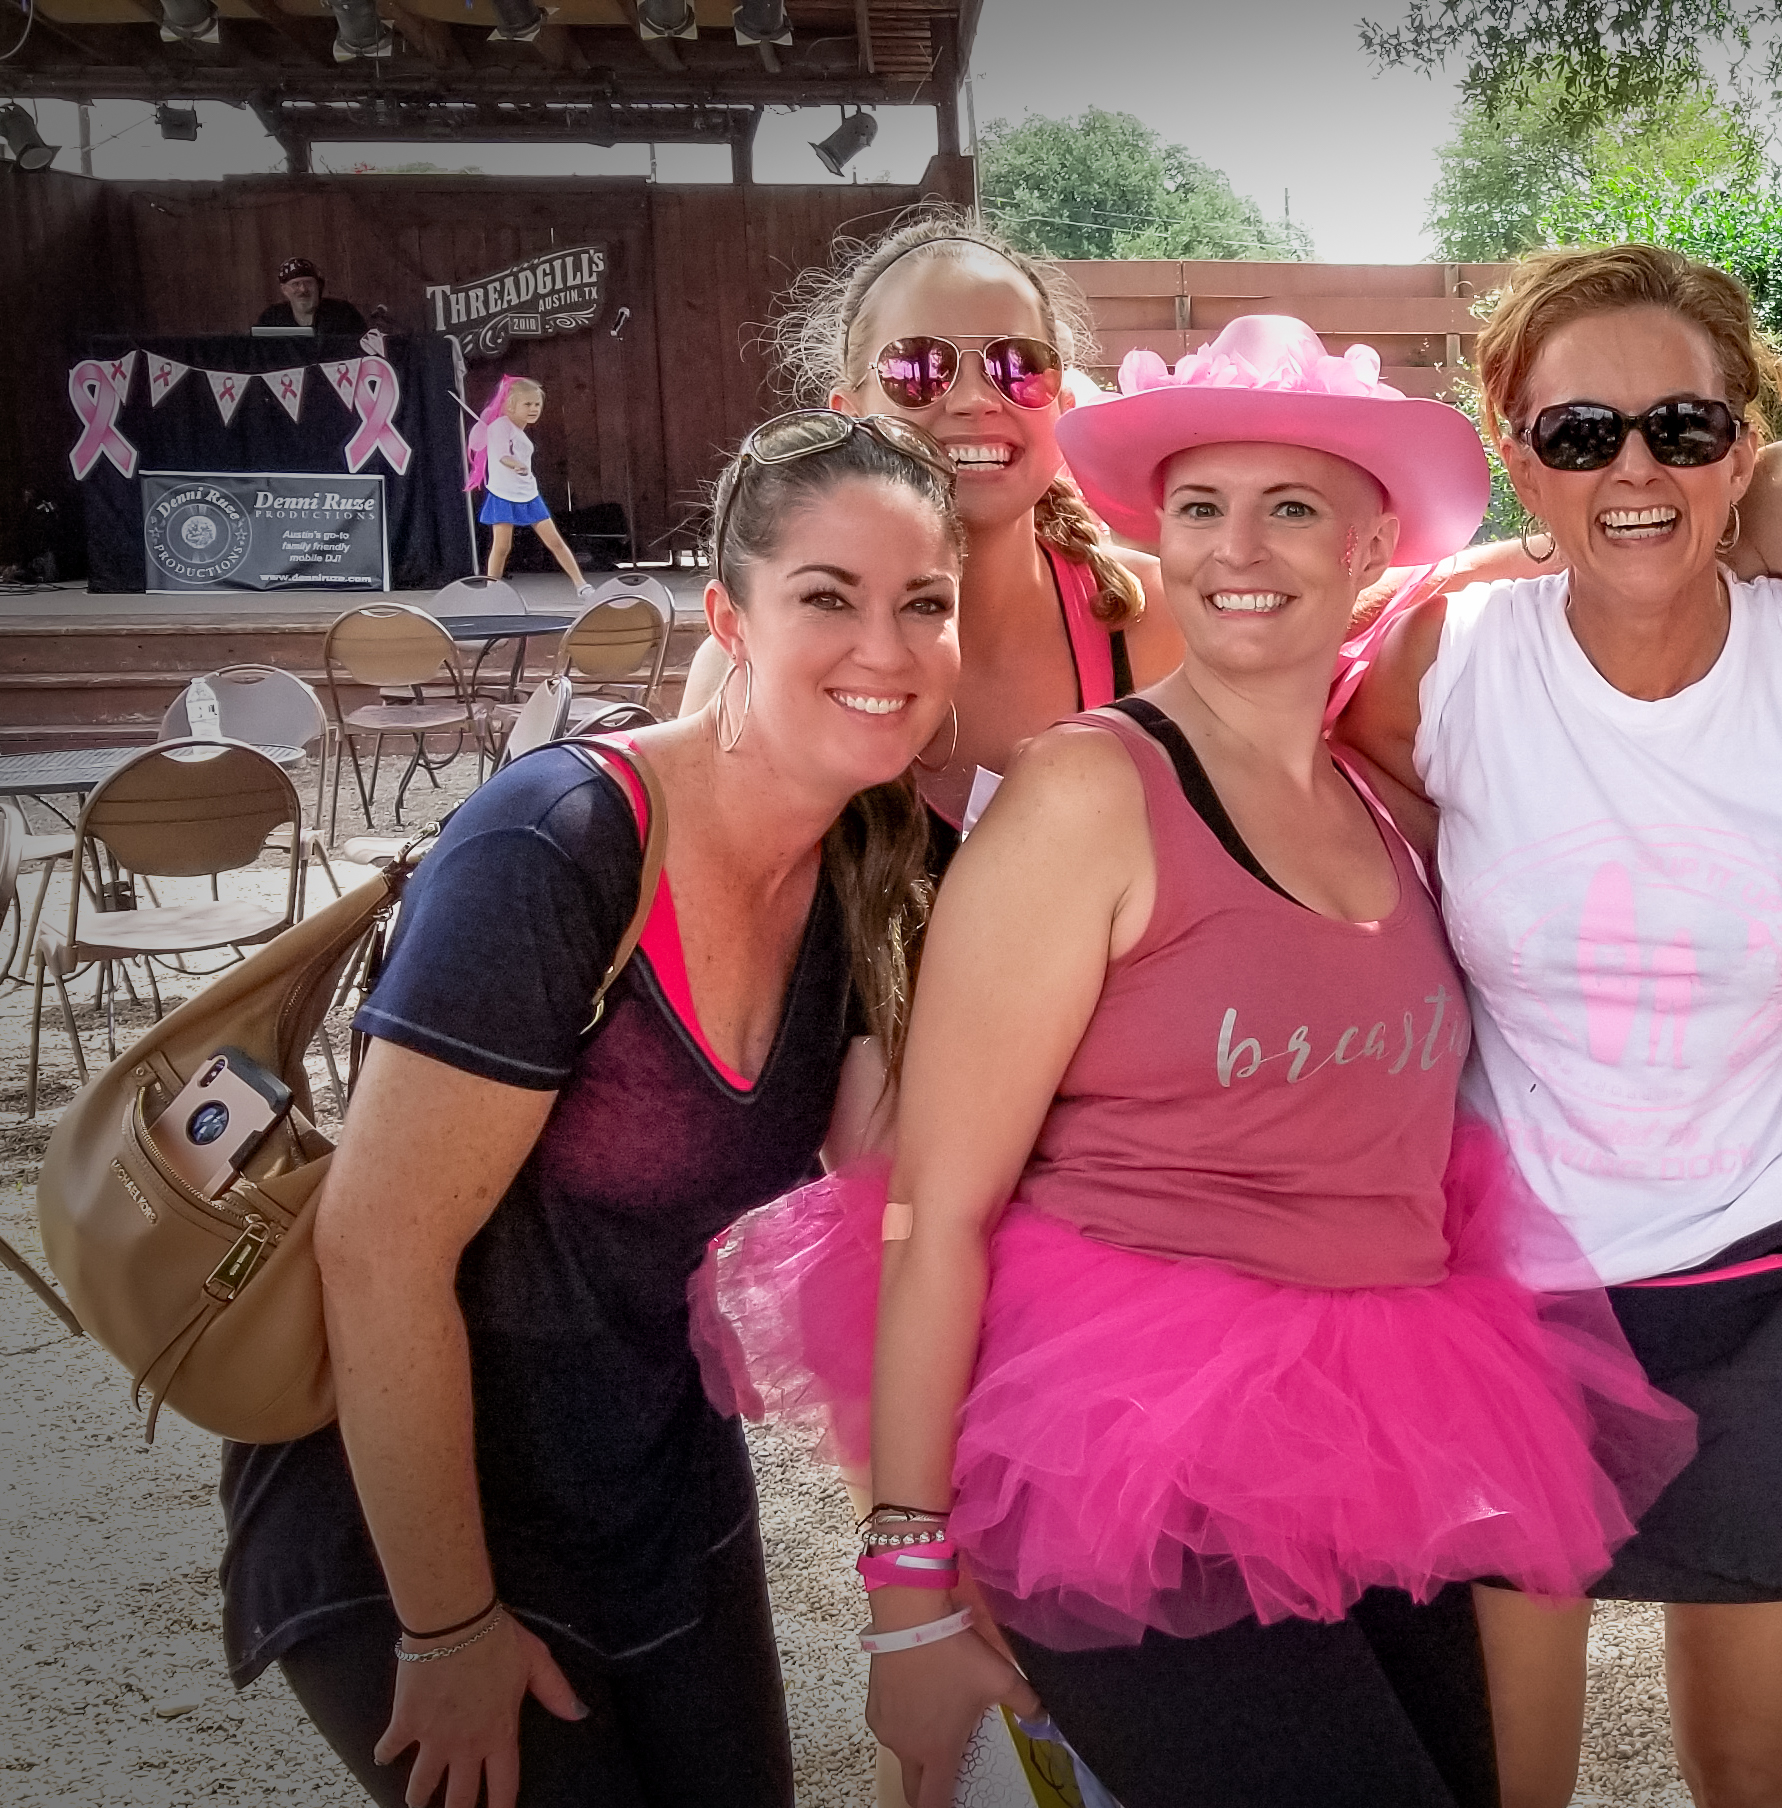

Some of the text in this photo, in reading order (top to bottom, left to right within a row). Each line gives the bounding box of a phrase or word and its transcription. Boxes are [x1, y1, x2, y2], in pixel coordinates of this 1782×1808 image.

[426, 250, 605, 331] THREADGILL'S
[583, 286, 598, 300] TX
[156, 486, 204, 518] Denni
[254, 491, 375, 511] Denni Ruze
[255, 510, 375, 520] PRODUCTIONS
[282, 530, 321, 539] Austin's
[282, 542, 350, 553] family friendly
[153, 544, 243, 577] PRODUCTIONS
[289, 554, 322, 562] mobile
[259, 574, 372, 583] www.denniruze.com
[111, 1159, 141, 1201] MCHAEL
